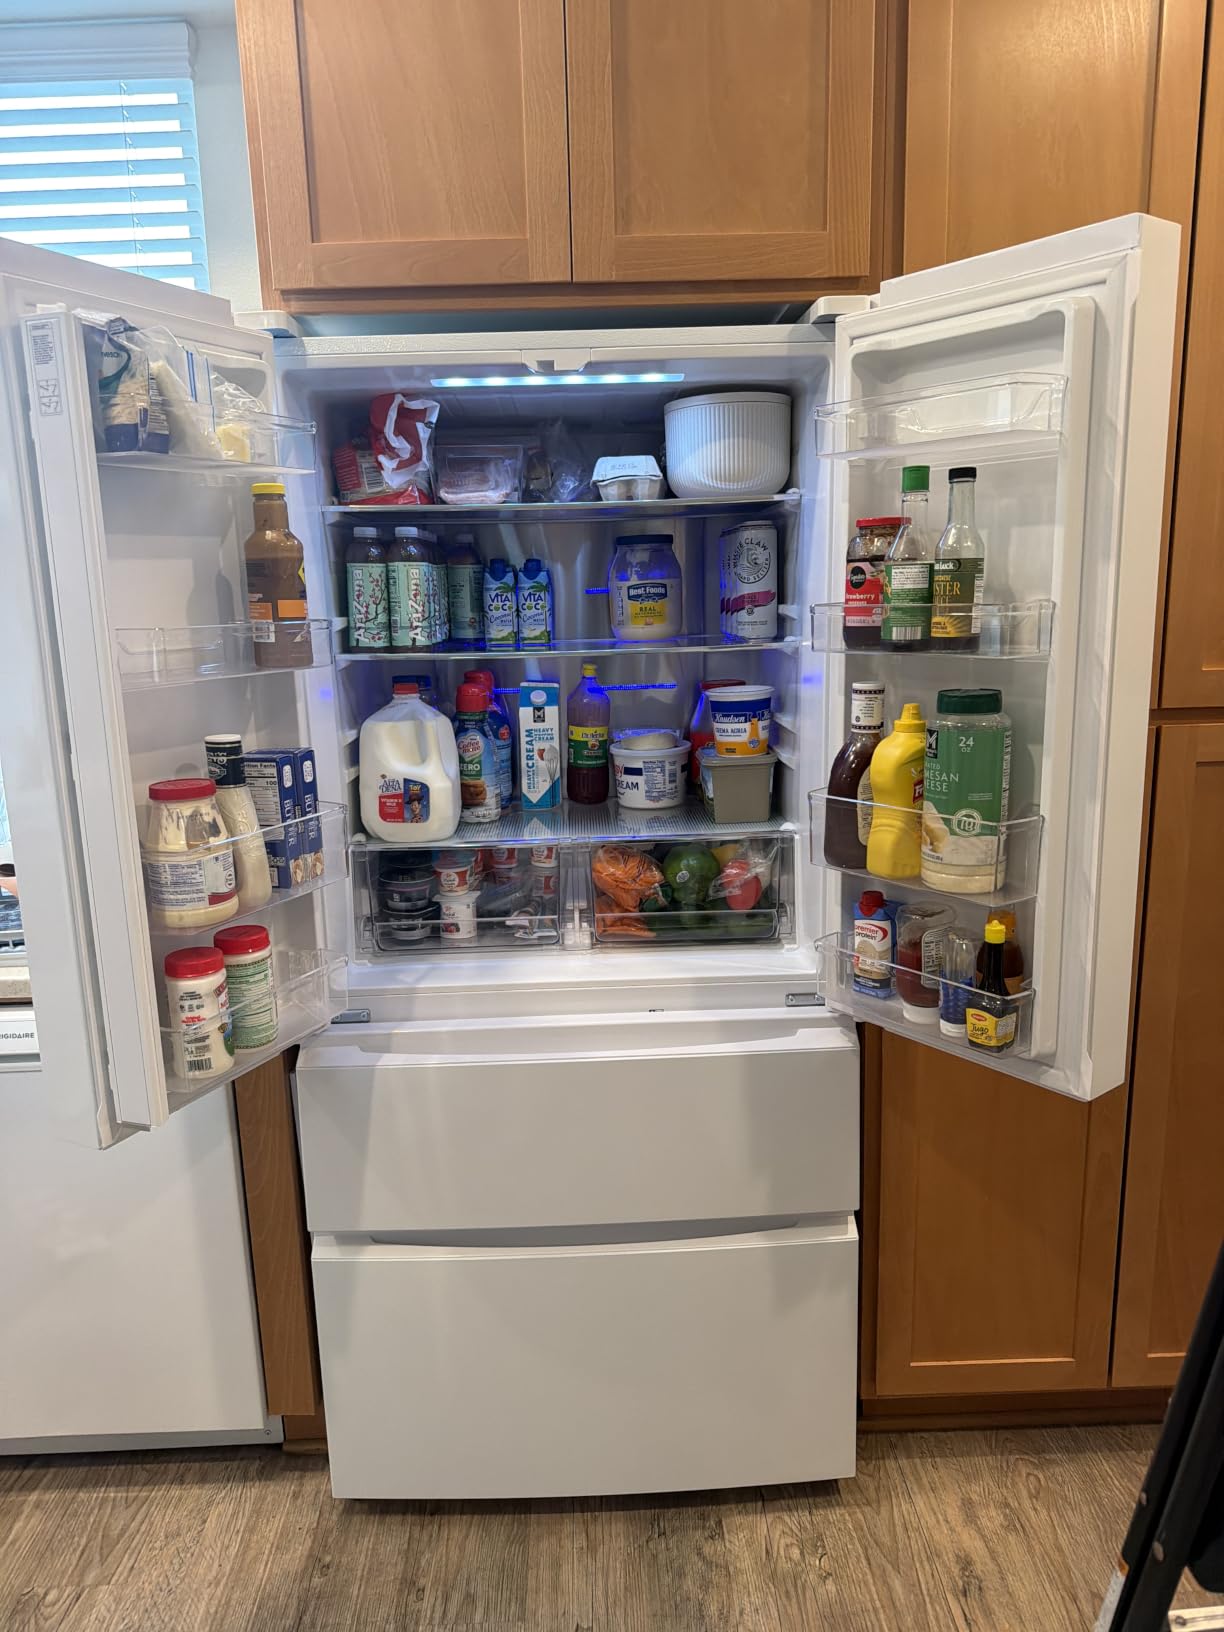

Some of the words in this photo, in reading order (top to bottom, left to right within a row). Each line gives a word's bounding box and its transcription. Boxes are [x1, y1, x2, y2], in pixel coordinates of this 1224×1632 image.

[744, 537, 769, 552] CLAW
[629, 587, 646, 596] Best
[646, 586, 666, 594] Foods
[934, 581, 961, 596] STER
[488, 592, 512, 603] VITA
[522, 591, 544, 603] VITA
[847, 593, 876, 601] rawberry
[714, 713, 746, 723] Knudsen
[959, 736, 975, 747] 24
[525, 728, 535, 769] CREAM
[926, 770, 959, 783] MESAN
[926, 779, 949, 792] EESE
[971, 1022, 989, 1035] Jugo
